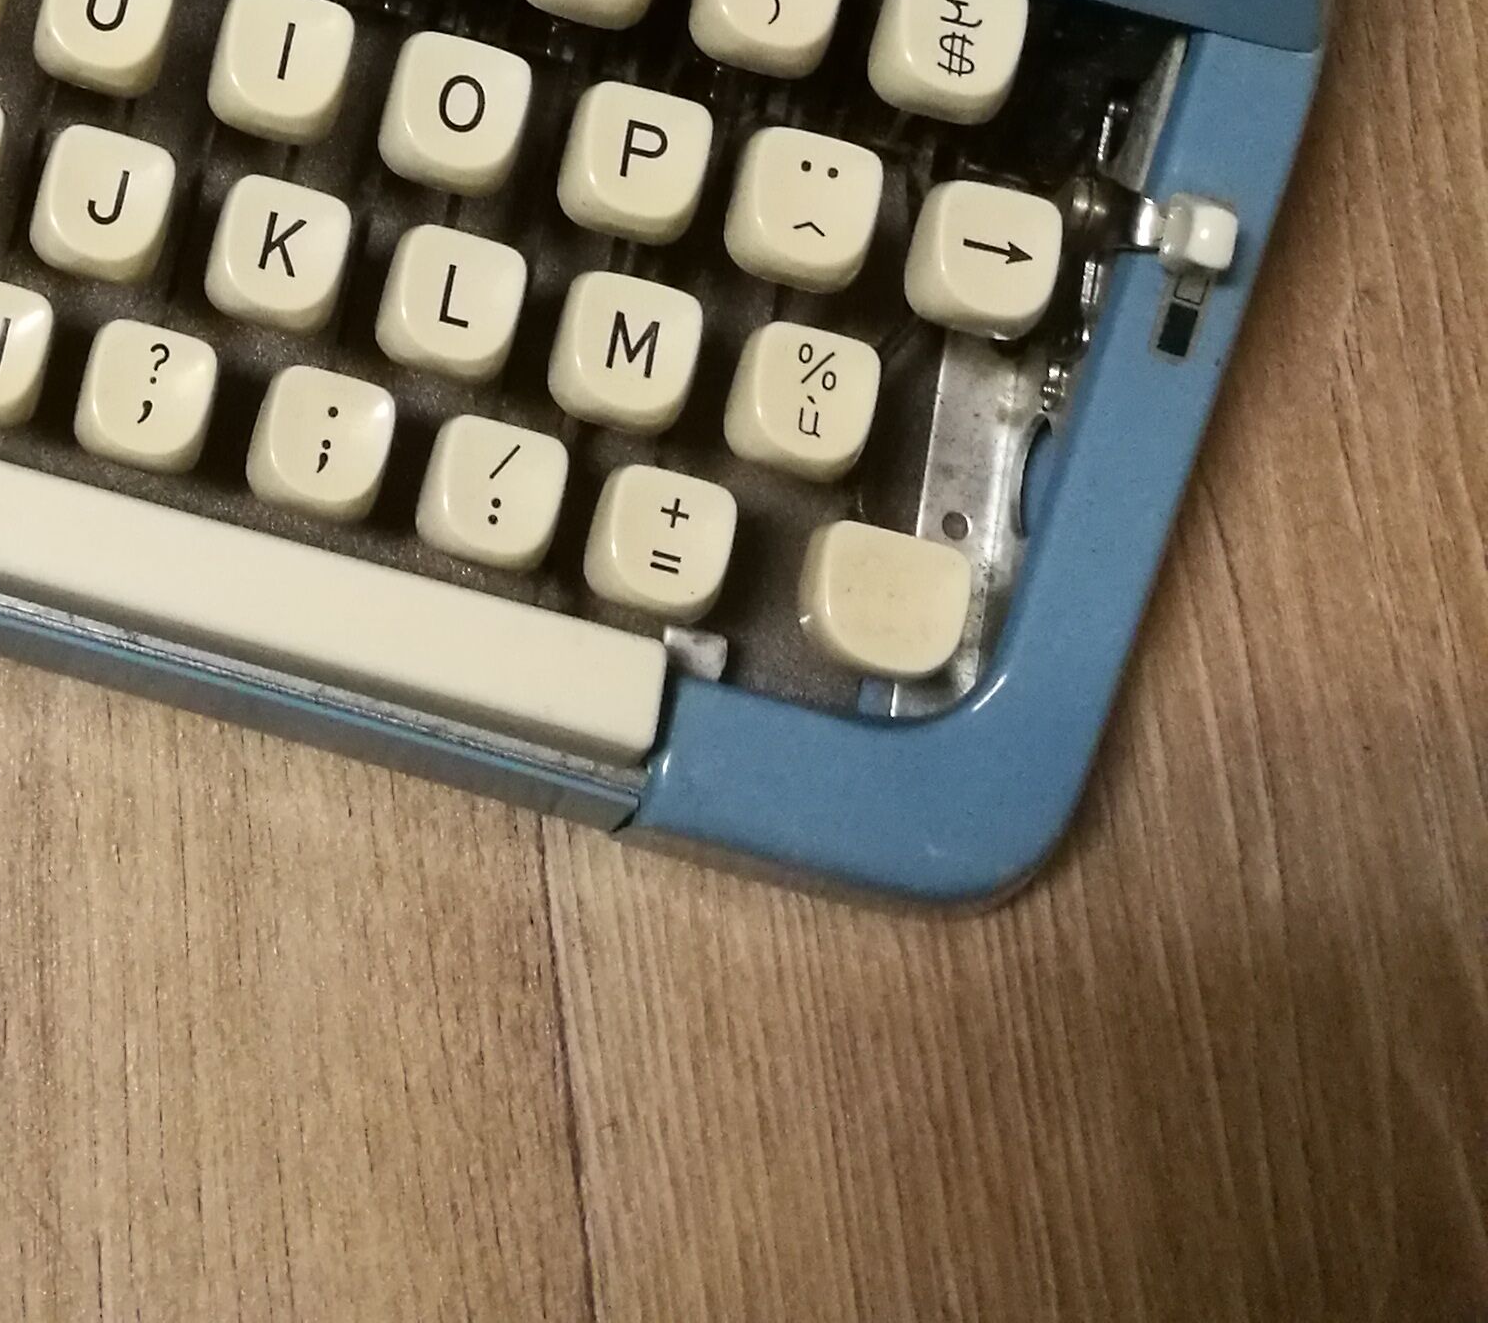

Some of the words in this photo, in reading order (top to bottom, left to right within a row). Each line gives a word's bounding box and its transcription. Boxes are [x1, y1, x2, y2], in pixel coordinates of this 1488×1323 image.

[277, 22, 297, 81] I
[937, 31, 976, 78] $
[438, 74, 487, 134] O
[619, 119, 669, 178] P
[86, 169, 131, 226] J
[257, 210, 308, 279] K
[438, 263, 470, 329] L
[148, 342, 171, 385] ?
[605, 310, 662, 379] M
[797, 342, 838, 393] %
[136, 399, 154, 425] ,
[797, 394, 822, 439] ù
[488, 443, 522, 481] /
[659, 497, 691, 529] +
[649, 548, 683, 575] =
